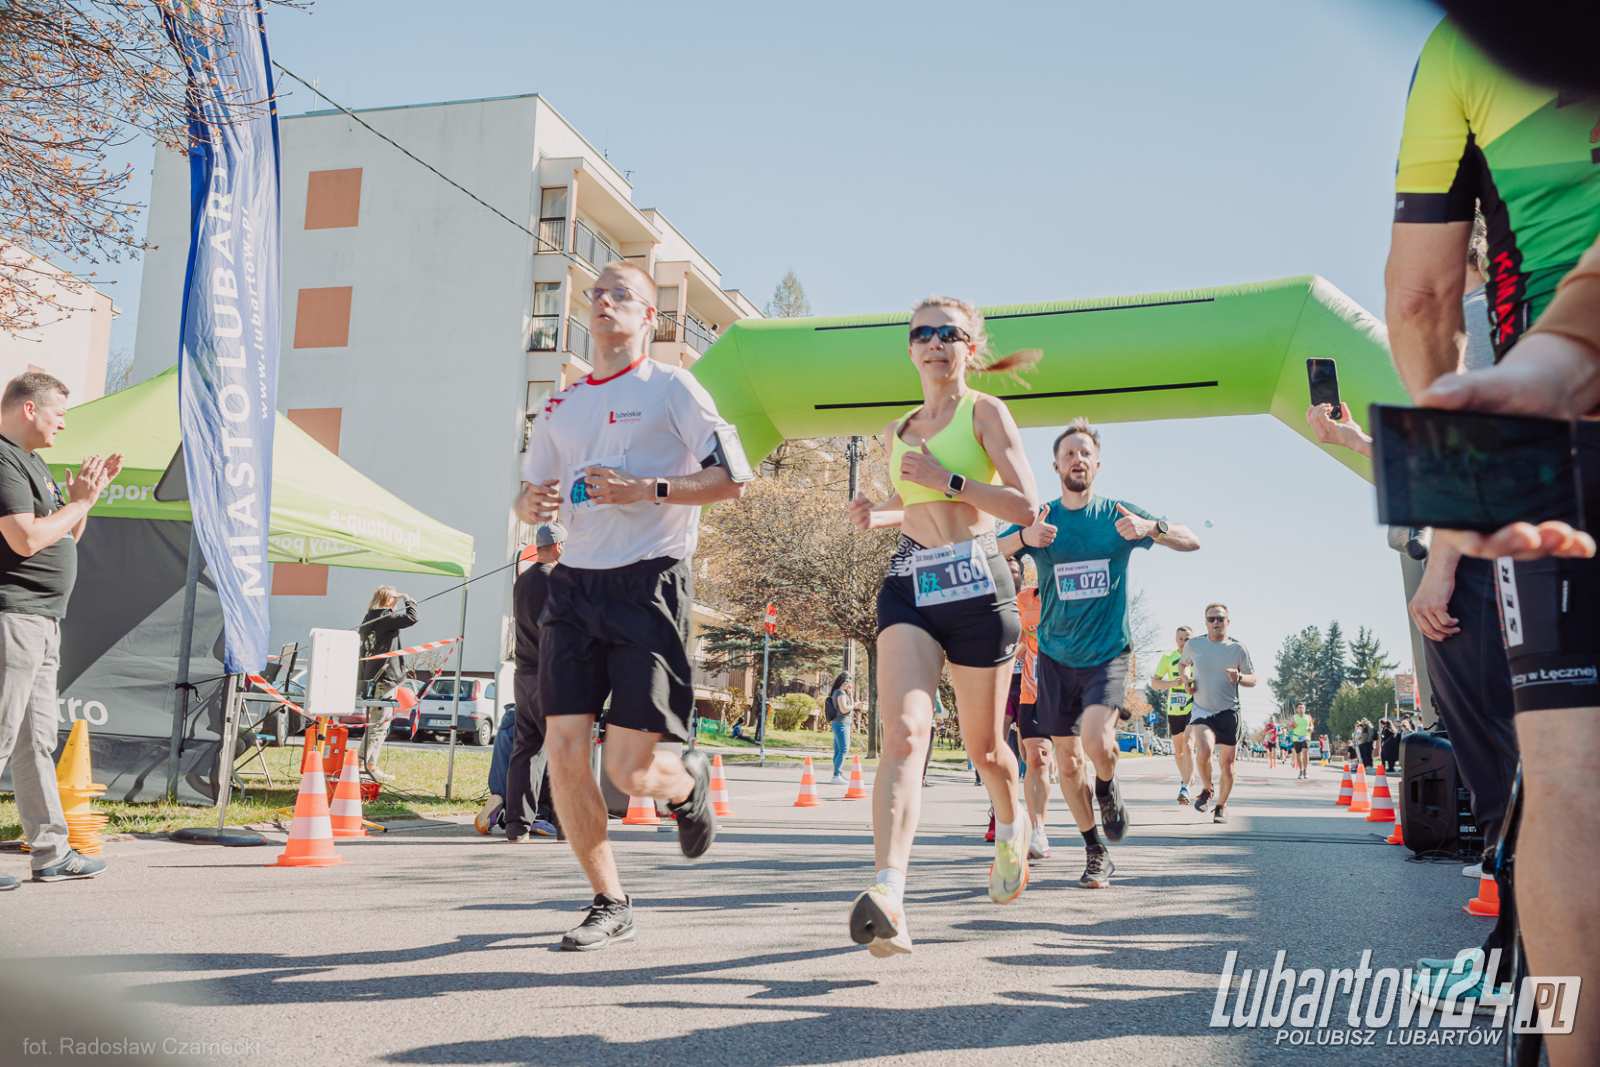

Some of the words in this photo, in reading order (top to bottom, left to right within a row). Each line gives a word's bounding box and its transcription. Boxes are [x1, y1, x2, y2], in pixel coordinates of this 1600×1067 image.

[208, 166, 247, 370] LUBAR
[239, 204, 269, 419] www.lubartow.pl
[219, 384, 266, 597] MIASTO
[944, 560, 984, 585] 160
[1079, 572, 1107, 589] 072
